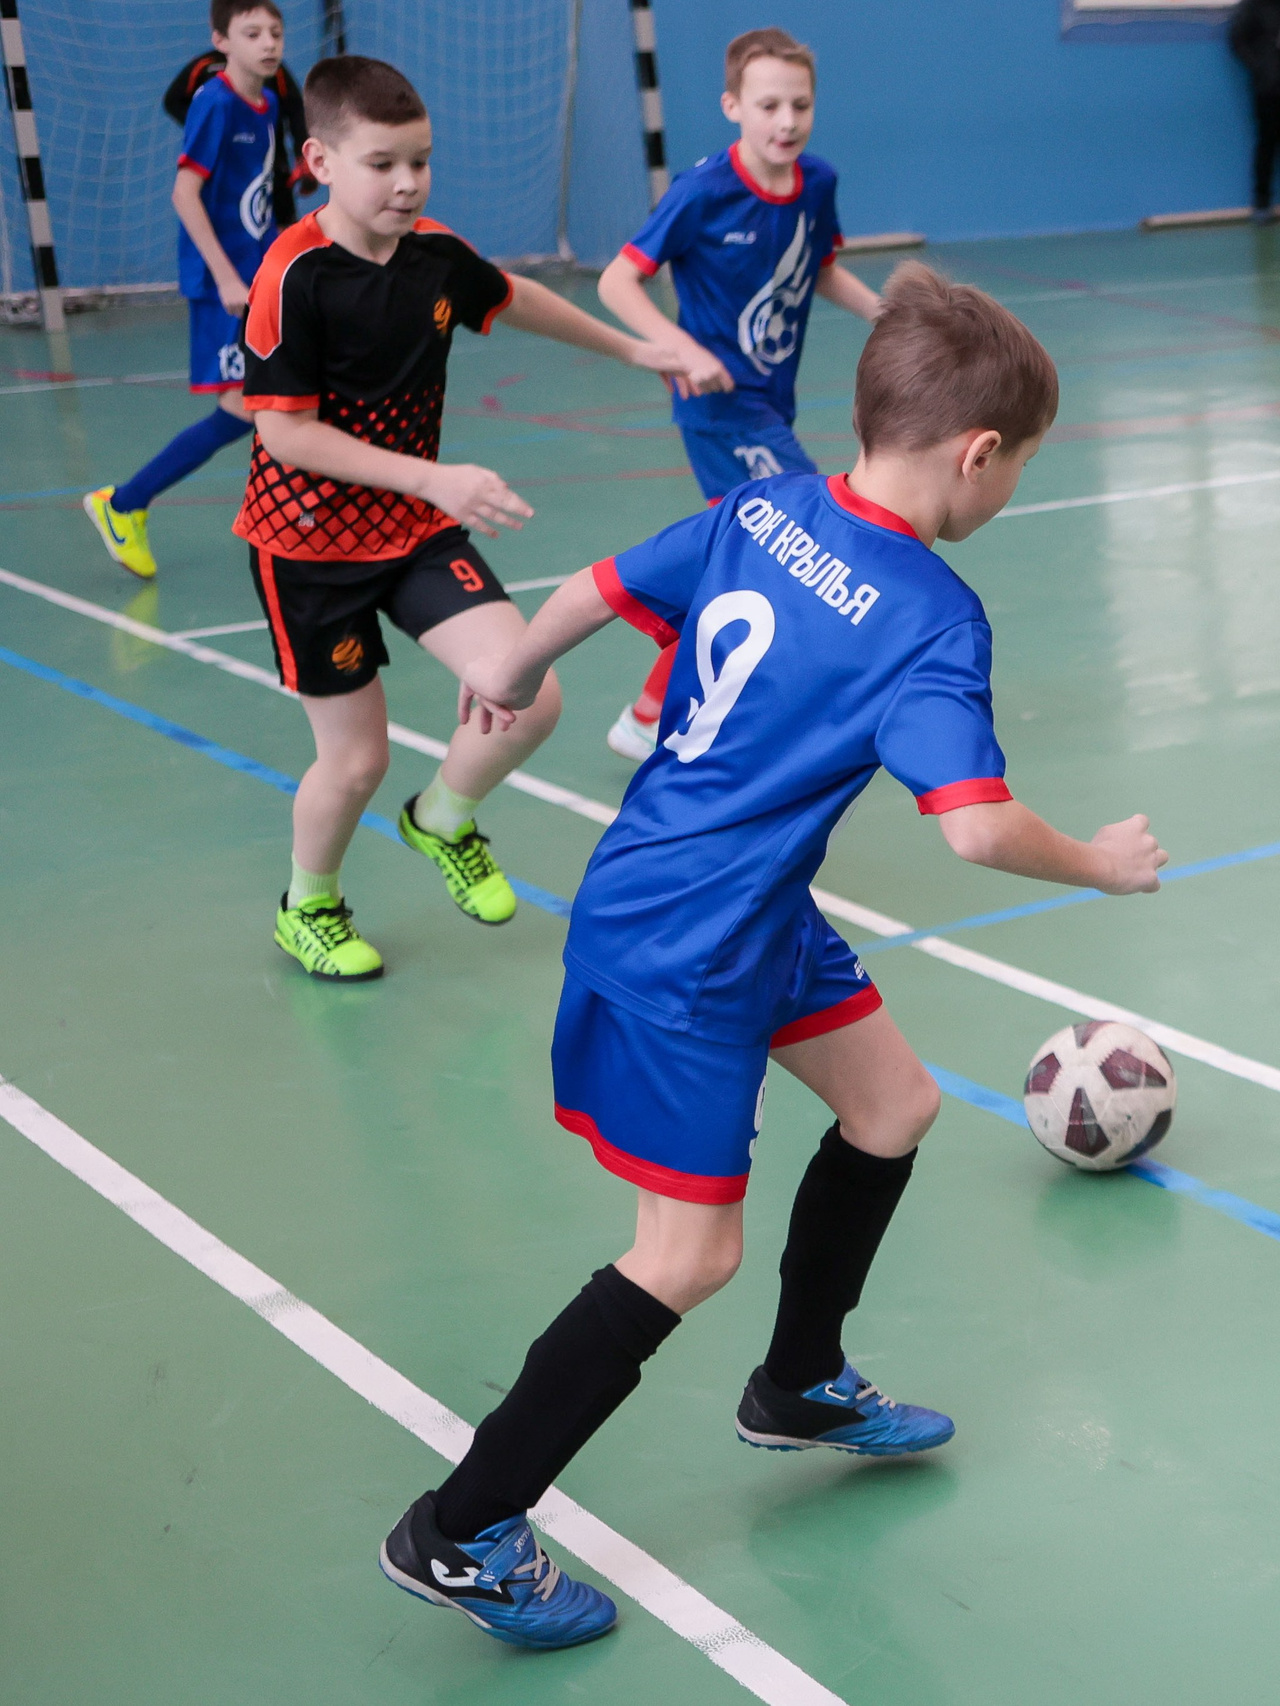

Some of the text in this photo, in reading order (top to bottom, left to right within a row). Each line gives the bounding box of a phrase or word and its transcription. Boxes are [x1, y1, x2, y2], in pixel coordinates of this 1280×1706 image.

[217, 343, 246, 381] 13
[450, 559, 484, 592] 9
[737, 497, 881, 626] ФК КРЫЛЬЯ
[663, 590, 776, 763] 9
